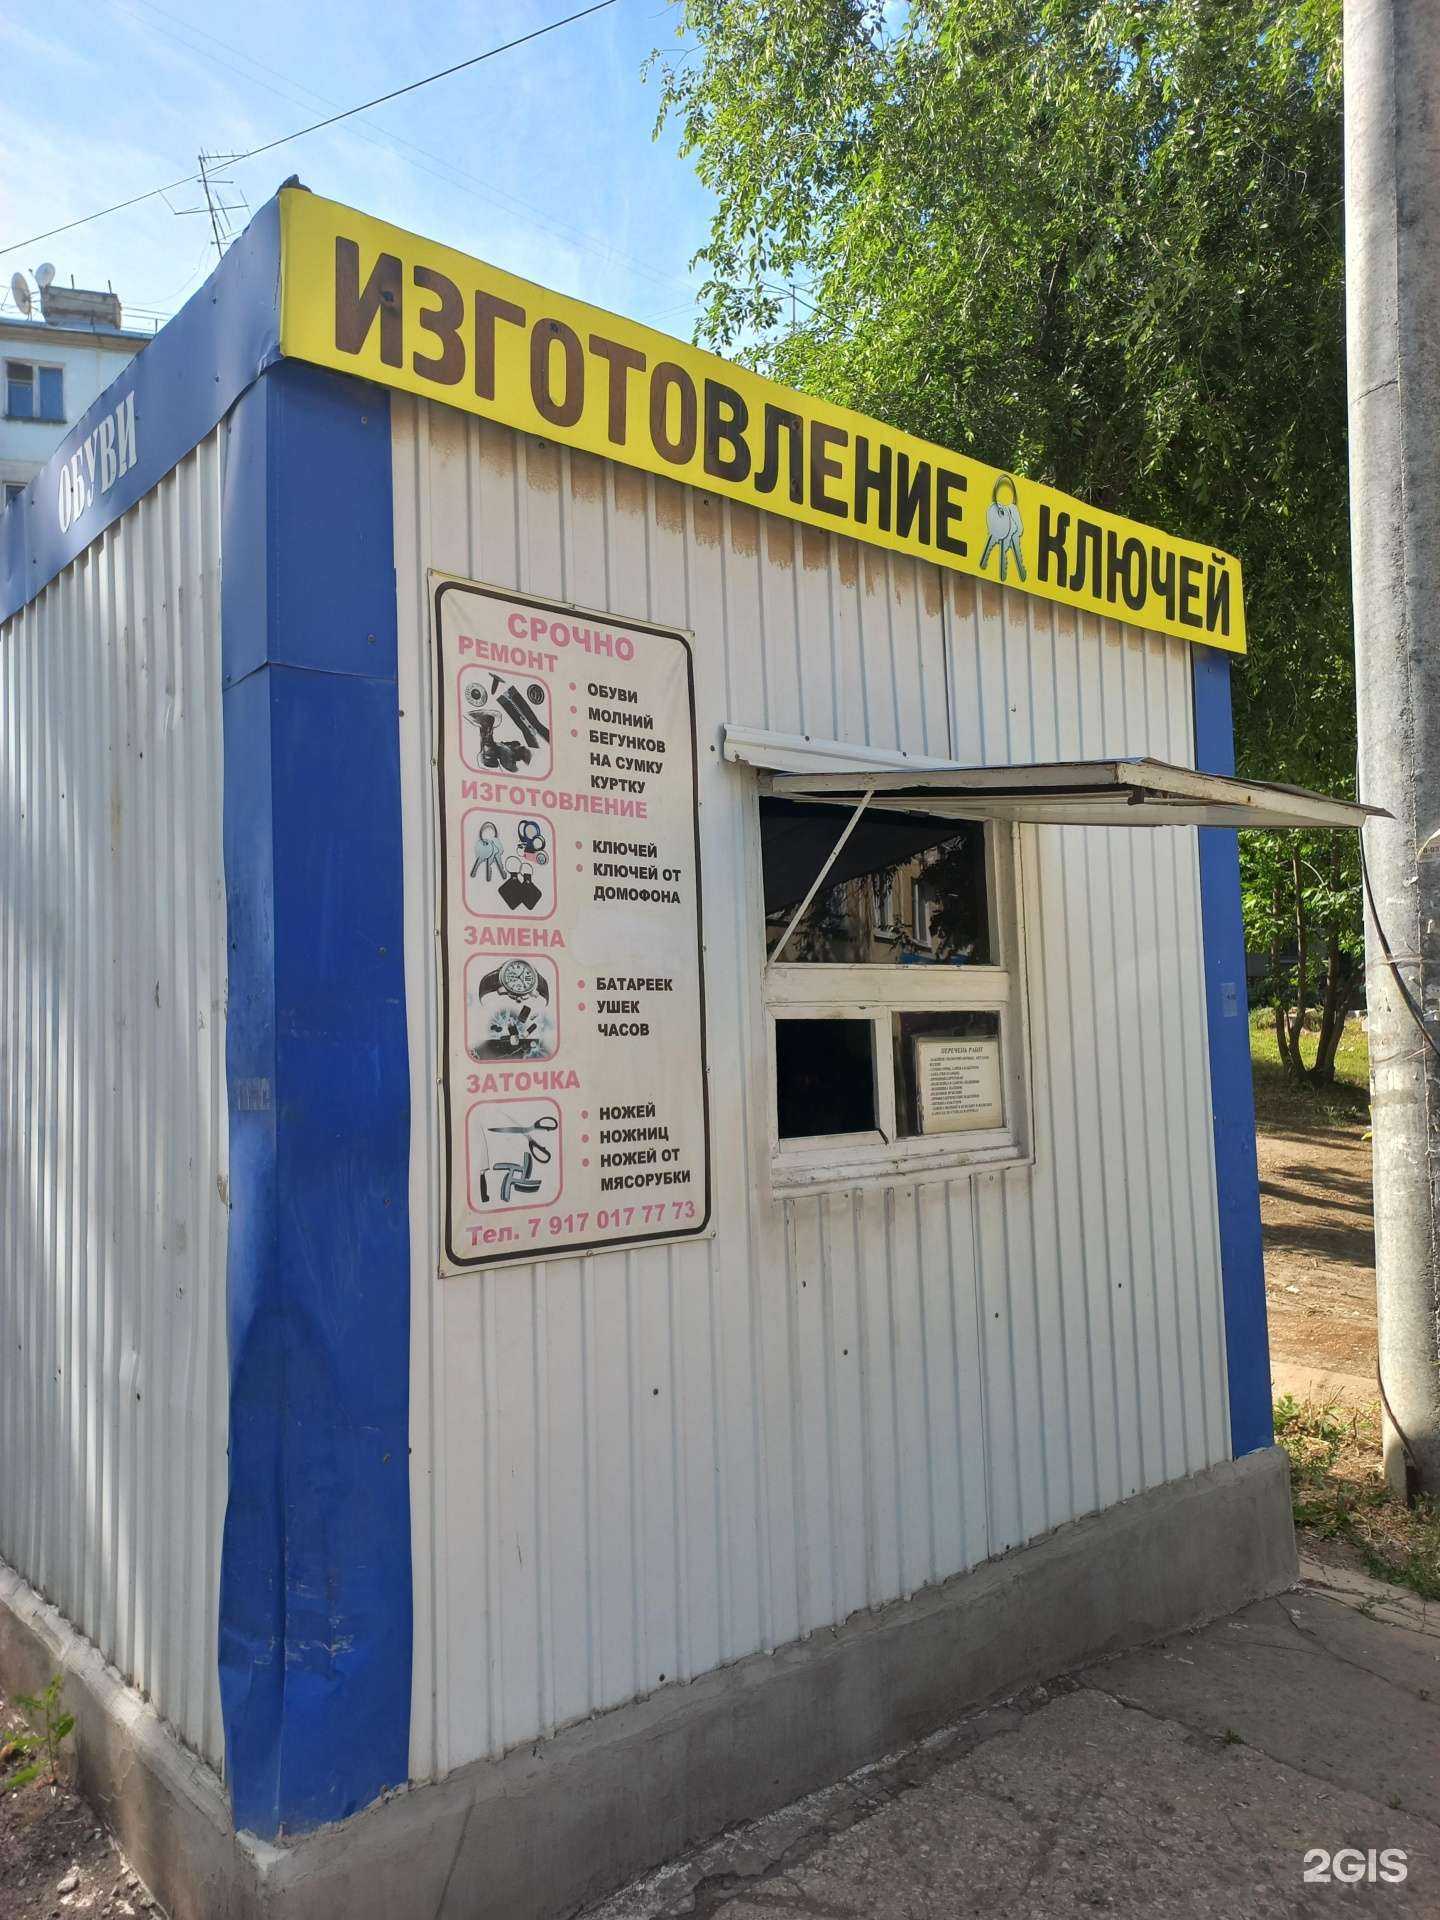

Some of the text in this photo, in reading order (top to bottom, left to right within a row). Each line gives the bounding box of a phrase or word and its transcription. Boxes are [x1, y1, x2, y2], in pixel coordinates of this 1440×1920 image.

[334, 236, 1231, 636] ИЗГОТОВЛЕНИЕ КЛЮЧЕЙ
[59, 390, 137, 533] ОБУВИ
[507, 613, 634, 661] СРОЧНО
[459, 635, 558, 672] РЕМОНТ
[587, 683, 638, 704] ОБУВИ
[588, 706, 654, 730] МОЛНИЙ
[589, 730, 666, 753] БЕГУНКОВ
[590, 753, 663, 775] НА СУМКУ
[590, 775, 645, 794] КУРТКУ
[461, 780, 648, 819] ИЗГОТОВЛЕНИЕ
[593, 840, 658, 859] КЛЮЧЕЙ
[593, 863, 681, 882] КЛЮЧЕЙ ОТ
[593, 886, 681, 904] ДОМОФОНА
[464, 926, 565, 948] ЗАМЕНА
[596, 977, 673, 991] БАТАРЕЕК
[597, 1000, 640, 1015] УШЕК
[598, 1023, 649, 1036] ЧАСОВ
[466, 1069, 581, 1093] ЗАТОЧКА
[599, 1101, 656, 1121] НОЖЕЙ
[600, 1126, 669, 1144] НОЖНИЦ
[600, 1147, 680, 1168] НОЖЕЙ ОТ
[601, 1171, 691, 1191] МЯСОРУБКИ
[466, 1200, 696, 1246] Тел. 7 917 017 77 73
